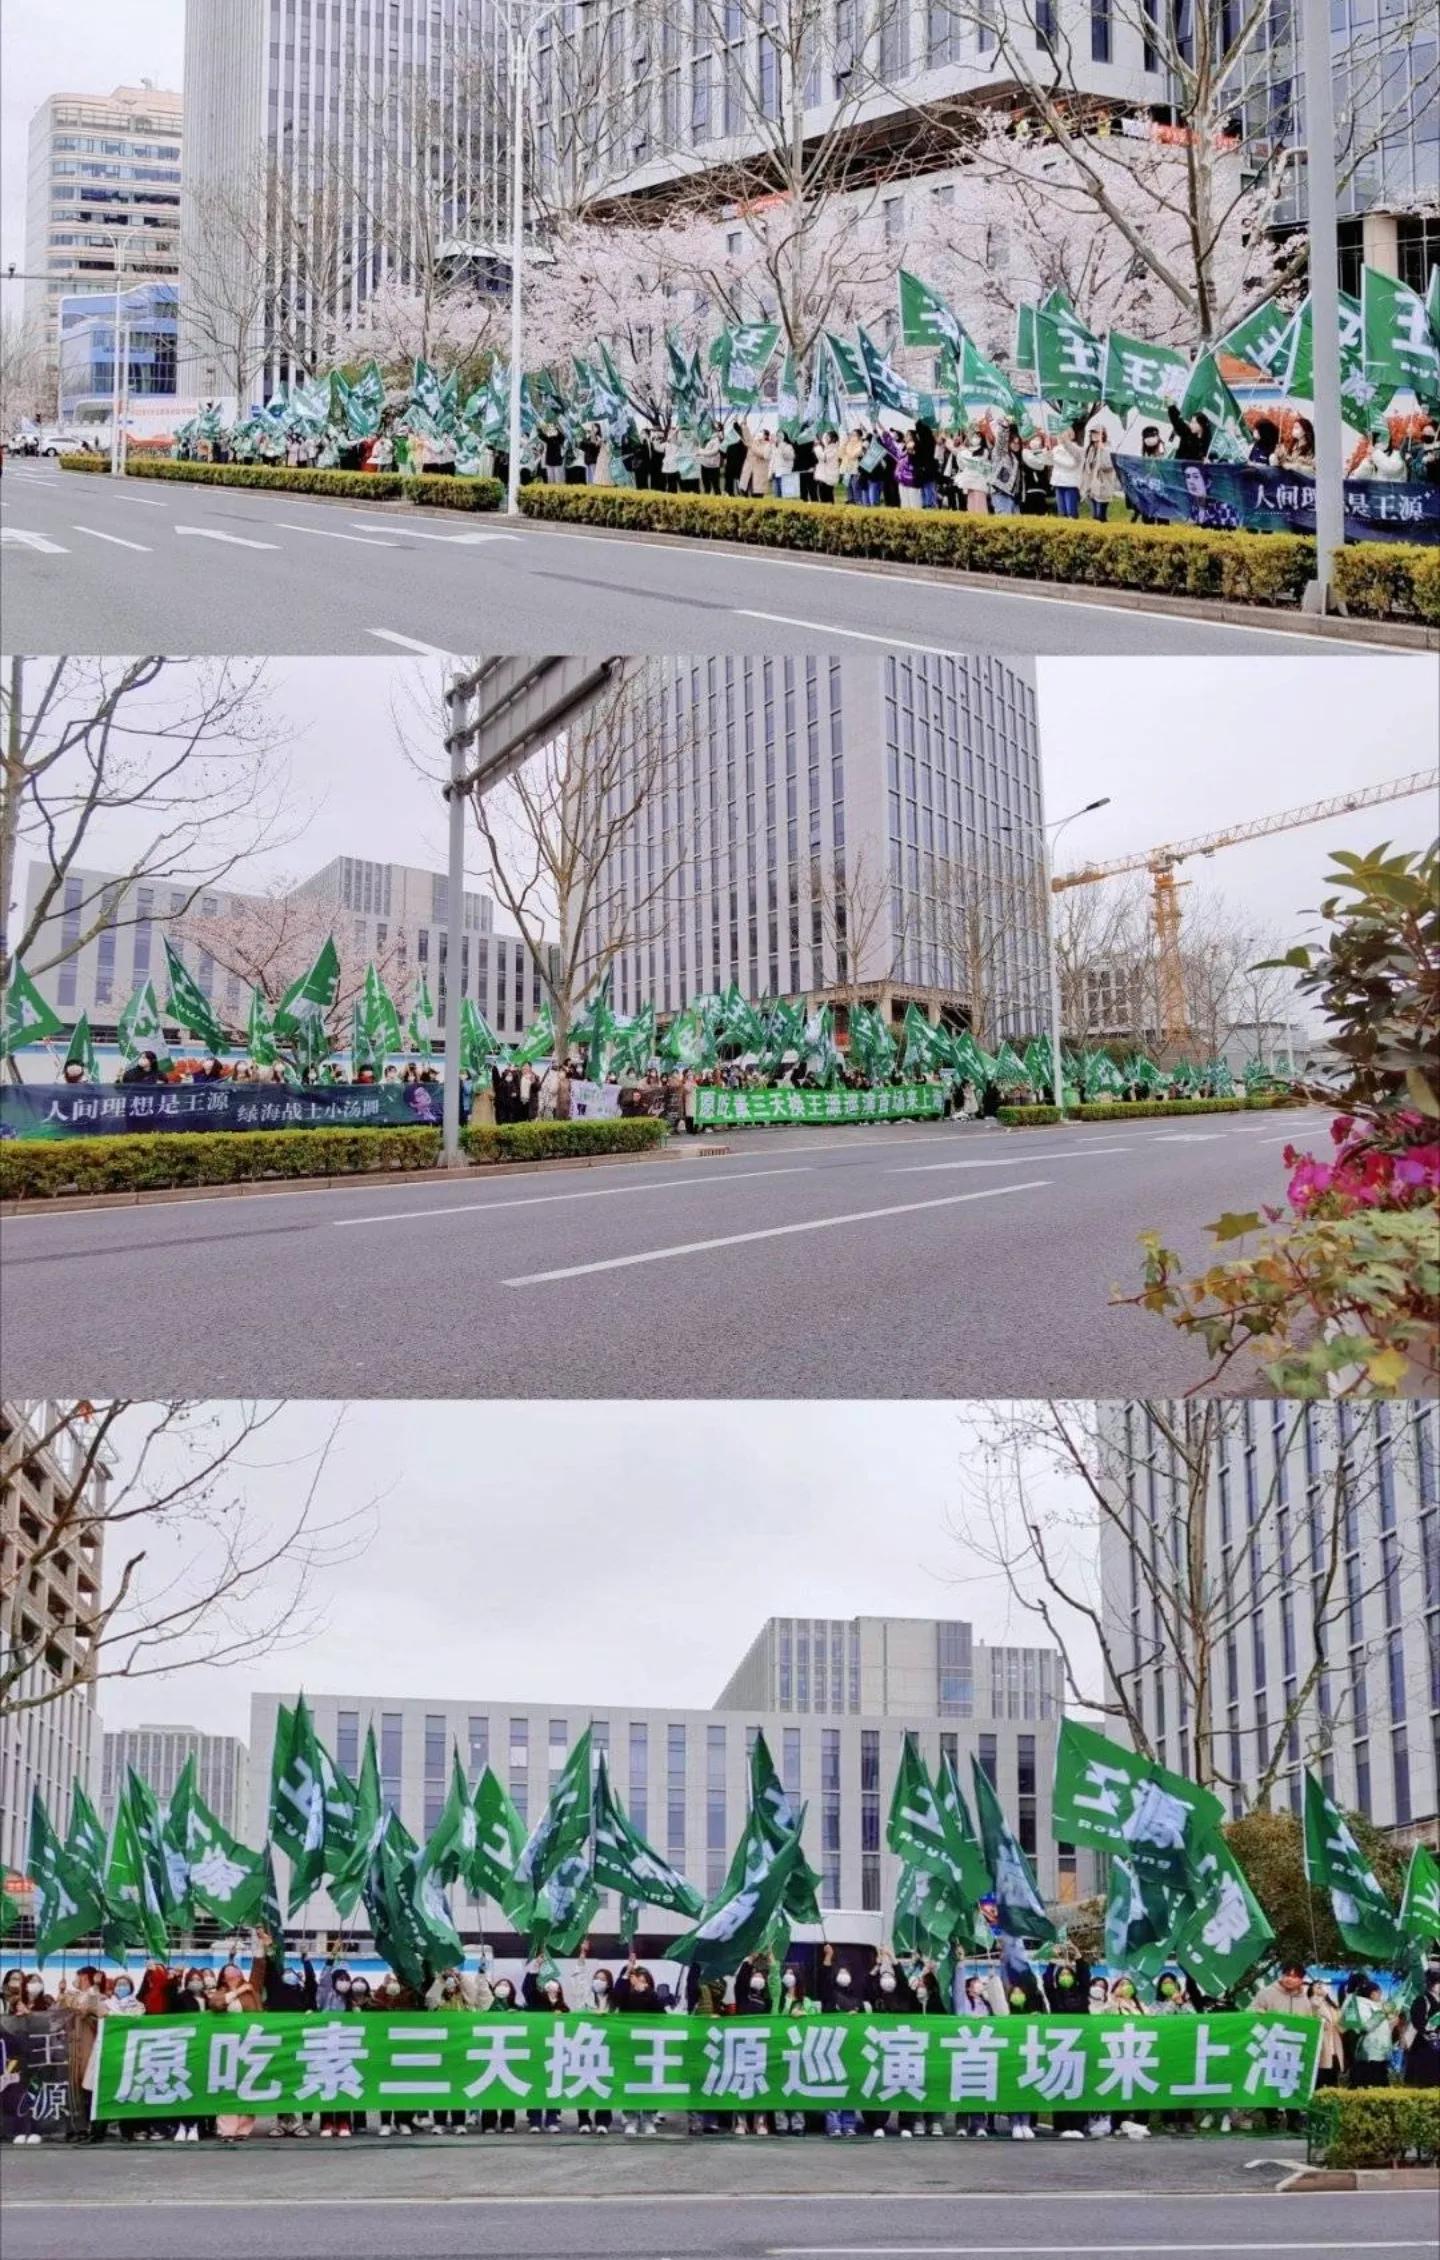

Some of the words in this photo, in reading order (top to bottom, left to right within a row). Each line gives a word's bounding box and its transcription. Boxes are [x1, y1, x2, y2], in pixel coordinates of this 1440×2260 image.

[1254, 483, 1424, 521] 人间理是王源
[41, 1090, 229, 1123] 人间理想是王源
[17, 2029, 71, 2120] 王源
[114, 2020, 1307, 2104] 愿吃素三天换王源巡演首场来上海
